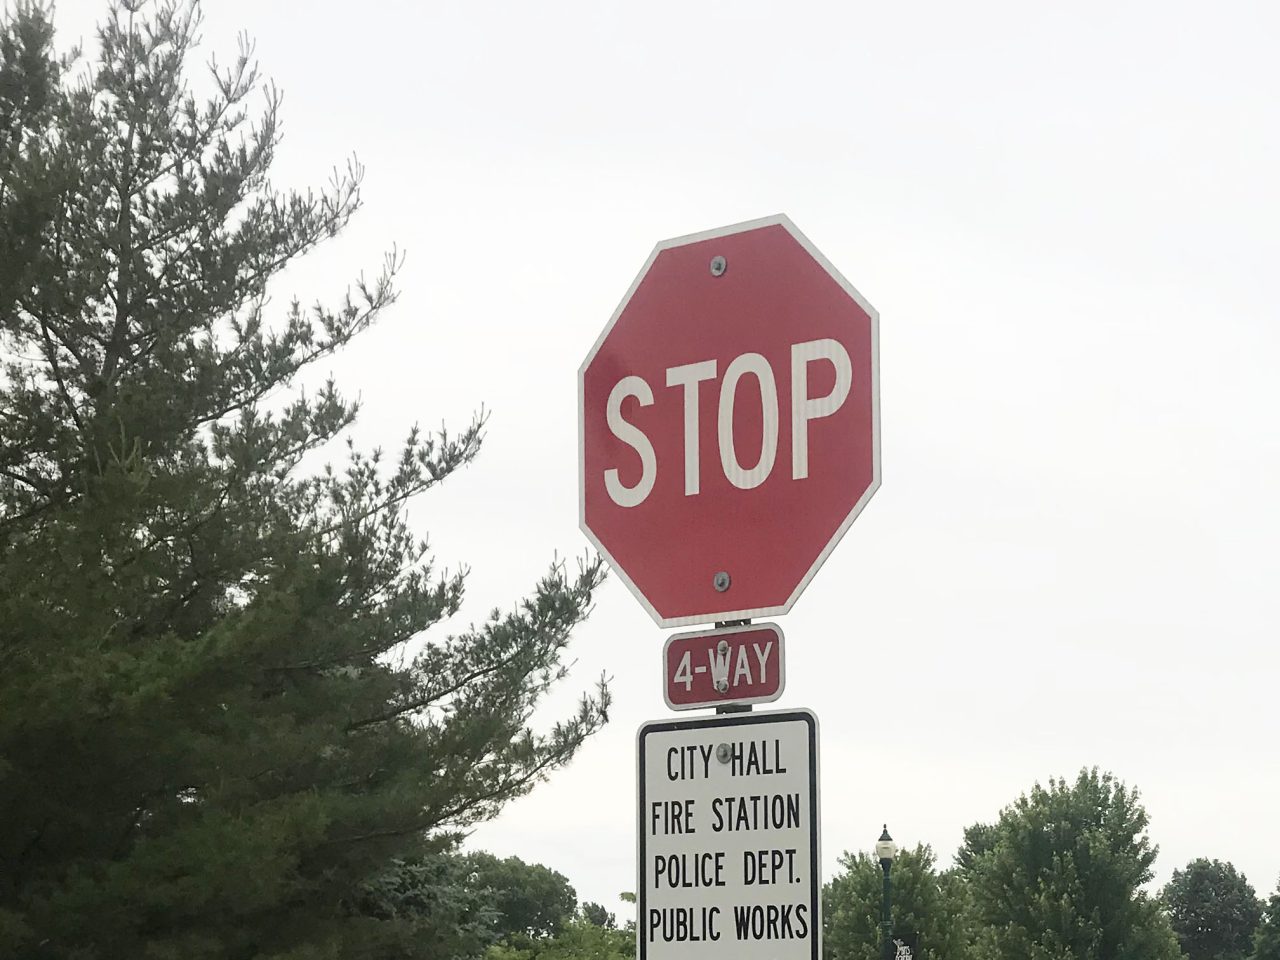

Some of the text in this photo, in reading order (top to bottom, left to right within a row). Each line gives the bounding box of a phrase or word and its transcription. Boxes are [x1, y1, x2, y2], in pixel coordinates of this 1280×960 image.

[604, 338, 852, 508] STOP
[673, 641, 773, 692] 4-WAY
[667, 739, 787, 781] CITY HALL
[652, 793, 800, 836] FIRE STATION
[655, 849, 801, 889] POLICE DEPT.
[649, 903, 808, 943] PUBLIC WORKS
